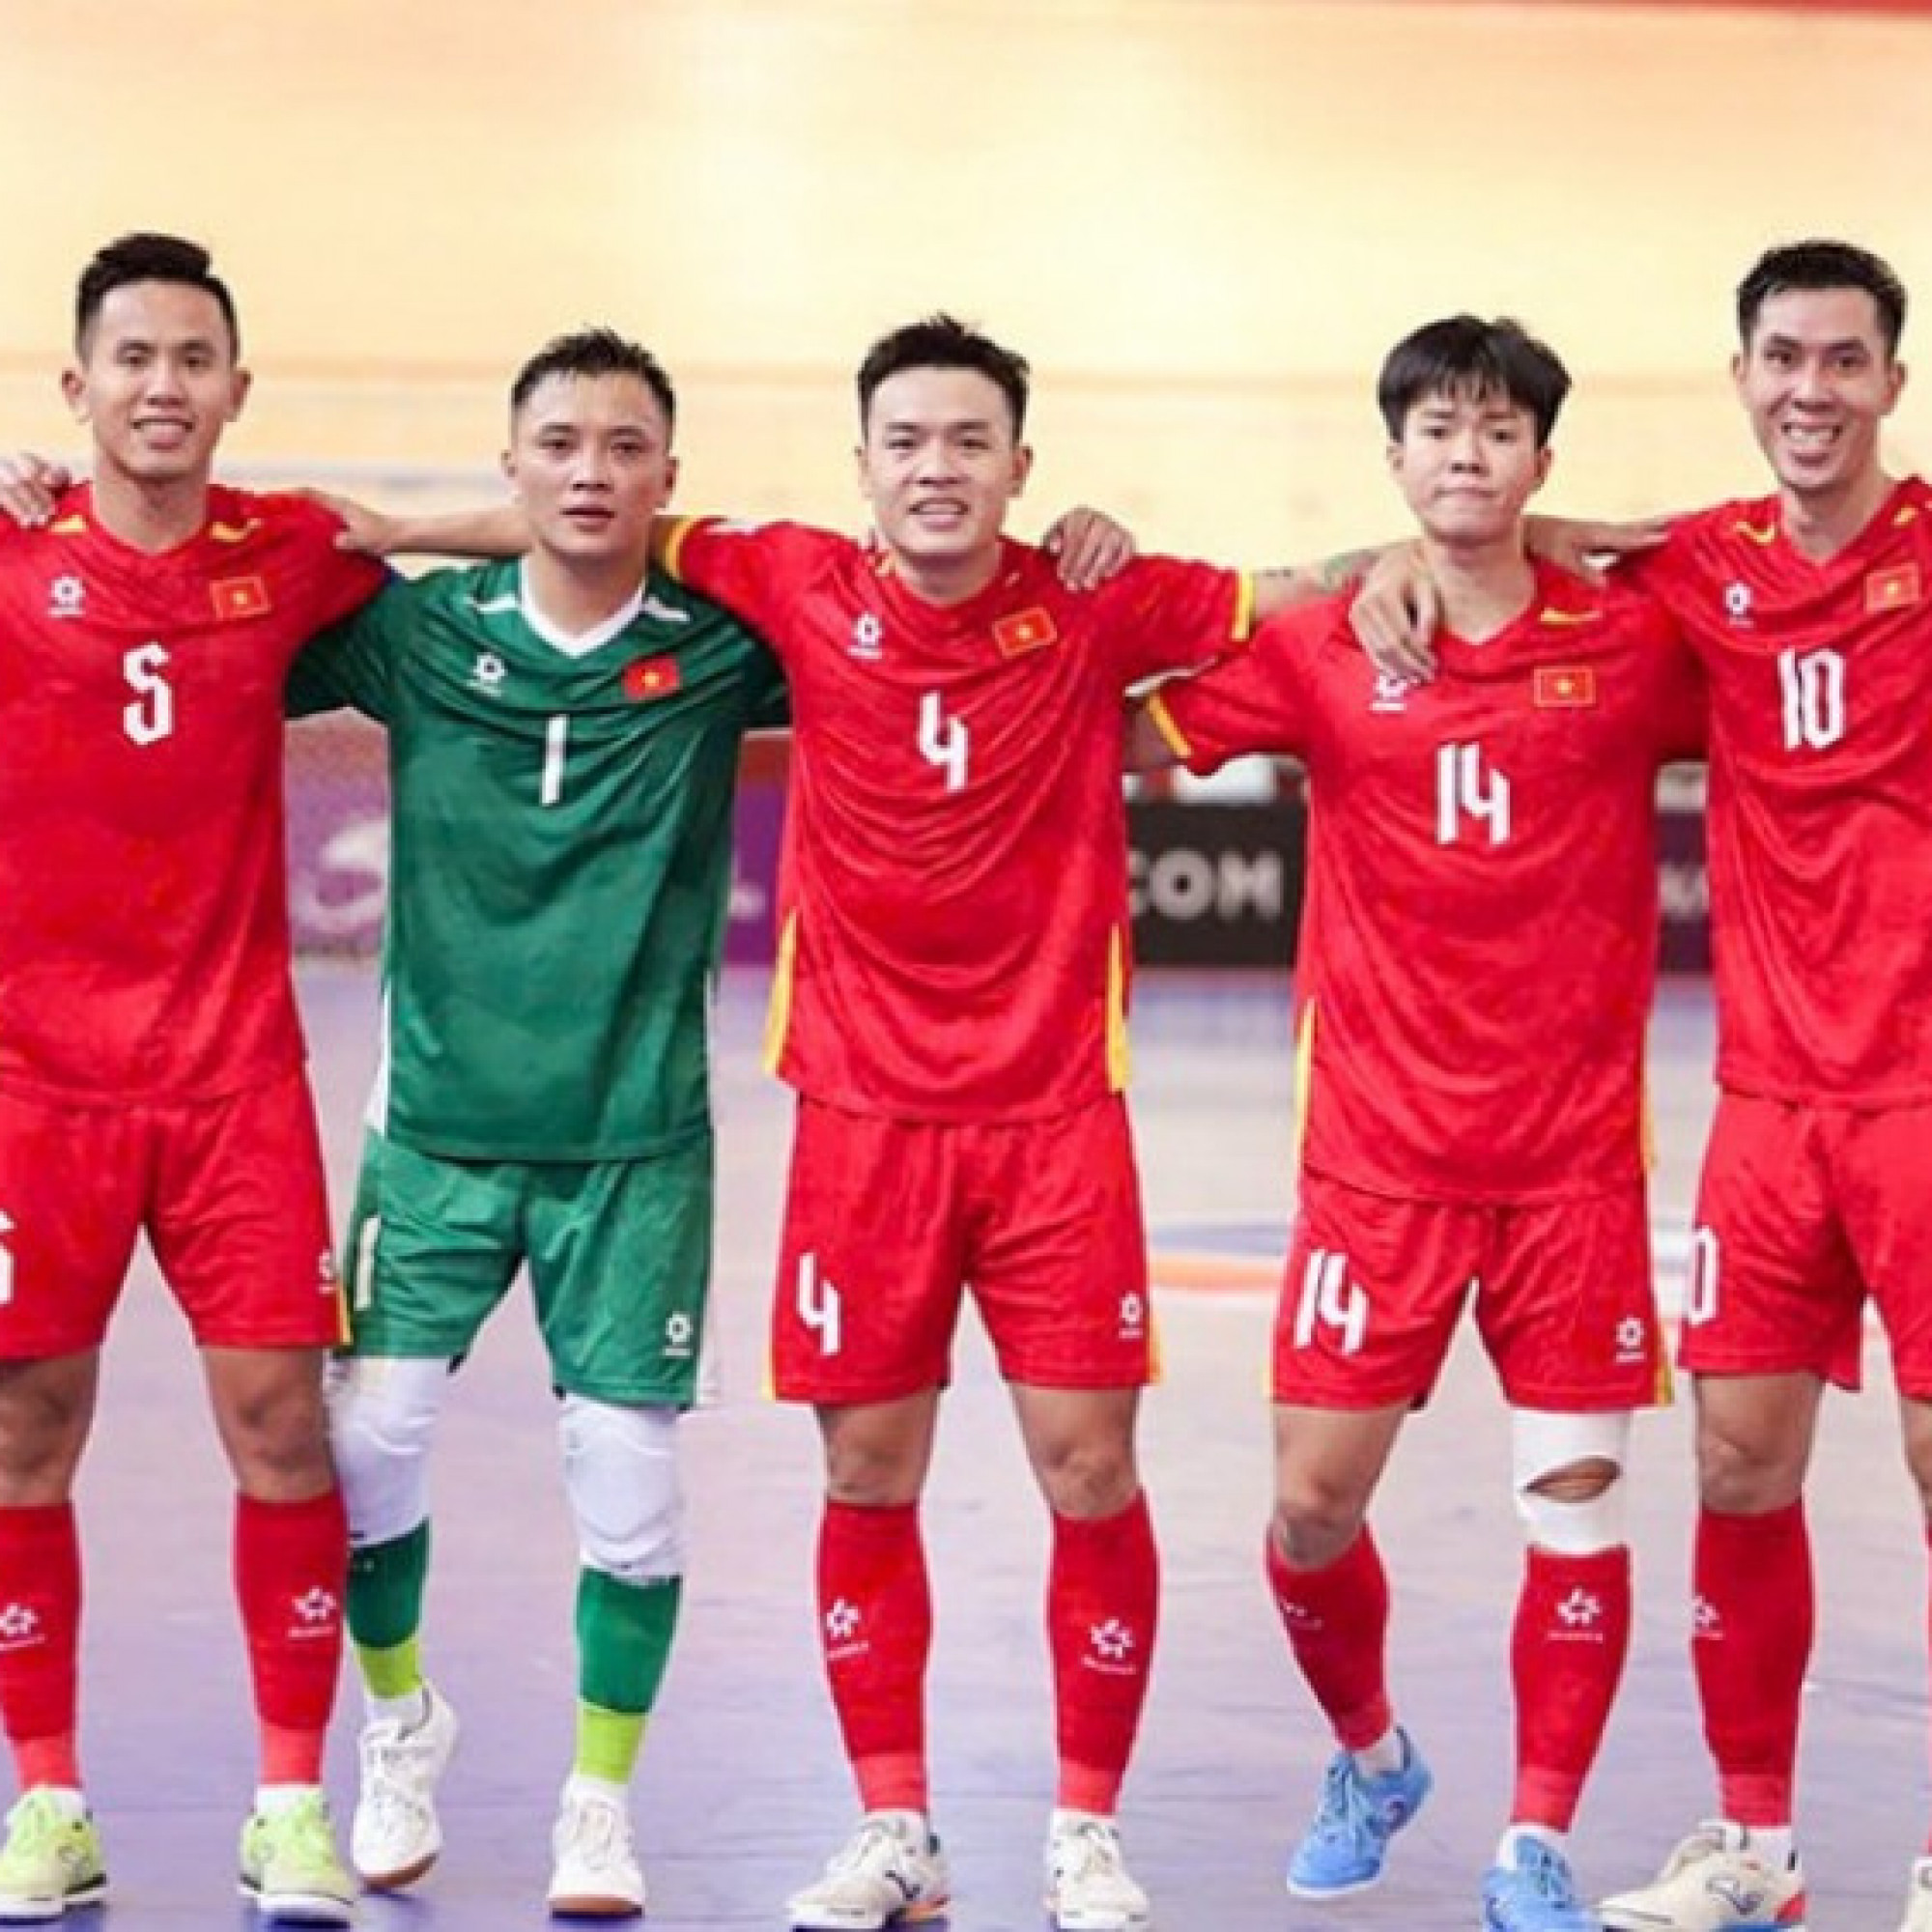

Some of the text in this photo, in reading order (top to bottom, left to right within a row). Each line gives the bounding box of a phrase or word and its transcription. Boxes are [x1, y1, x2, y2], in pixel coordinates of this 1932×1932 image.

[917, 691, 968, 792] 4
[1777, 647, 1845, 750] 10
[540, 714, 567, 806] 1
[1435, 742, 1511, 845] 14
[796, 1253, 840, 1355] 4
[1293, 1247, 1369, 1354] 14
